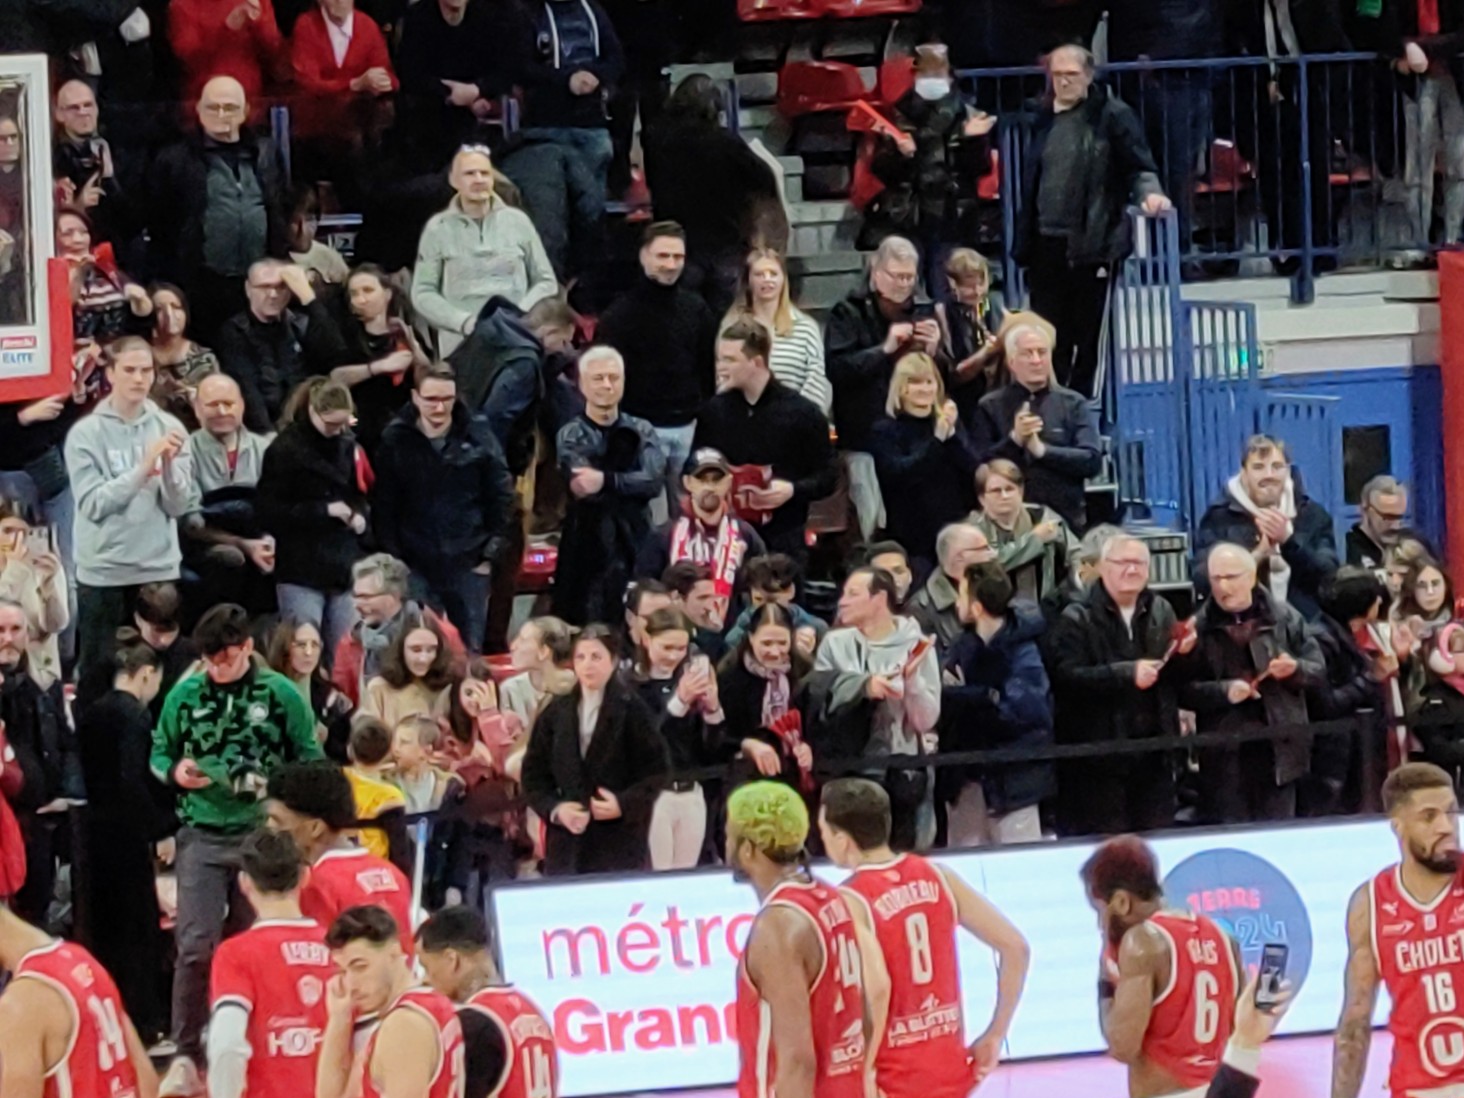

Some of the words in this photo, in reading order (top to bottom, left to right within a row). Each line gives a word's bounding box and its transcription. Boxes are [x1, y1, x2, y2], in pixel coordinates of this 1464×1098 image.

[905, 912, 933, 985] 8
[1194, 970, 1220, 1044] 6
[1421, 971, 1457, 1014] 16
